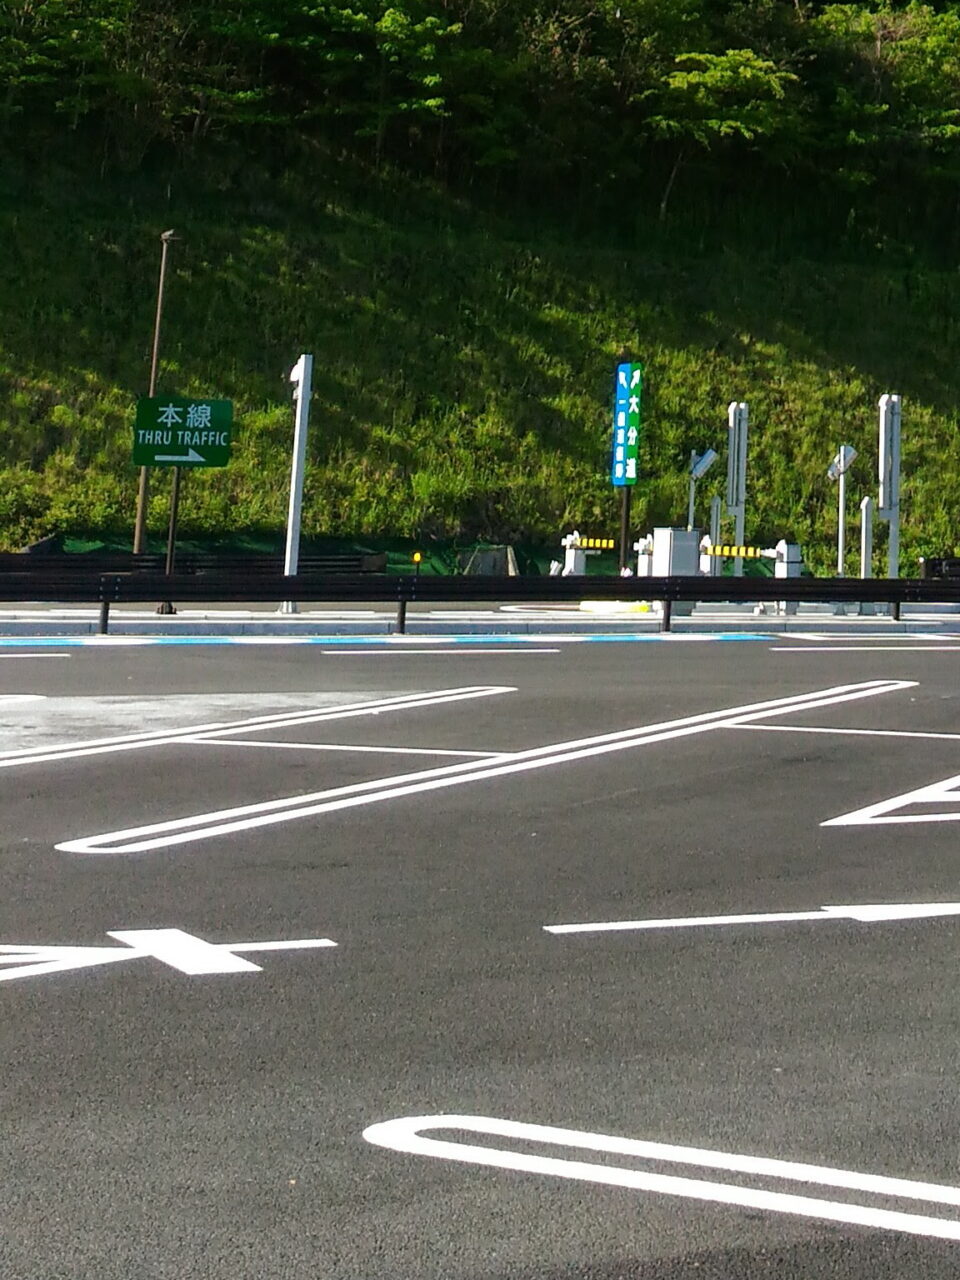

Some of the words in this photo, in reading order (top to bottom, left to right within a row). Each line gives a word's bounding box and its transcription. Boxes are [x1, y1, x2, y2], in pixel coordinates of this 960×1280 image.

[157, 403, 212, 428] 本線
[138, 430, 172, 445] THRU
[177, 431, 229, 446] TRAFFIC
